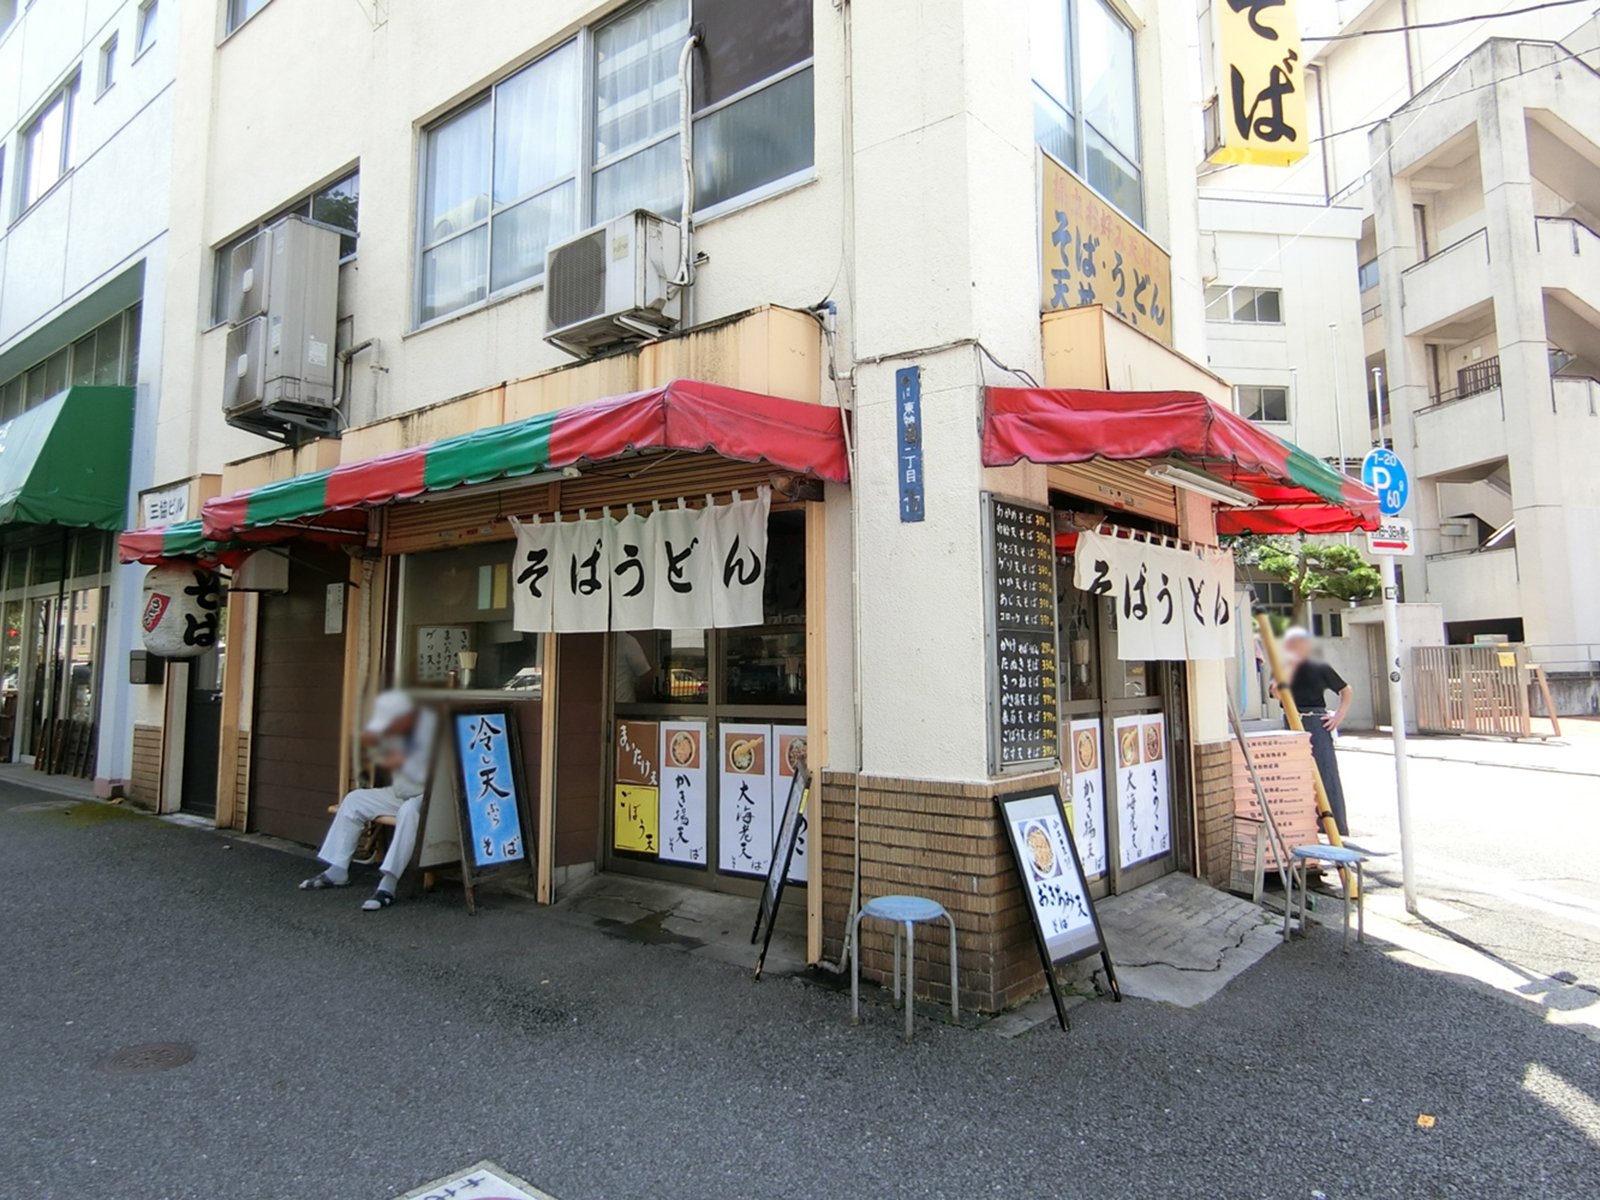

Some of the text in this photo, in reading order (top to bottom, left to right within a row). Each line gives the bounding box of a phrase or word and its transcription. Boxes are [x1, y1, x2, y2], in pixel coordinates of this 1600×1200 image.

[1373, 454, 1397, 466] 7-20
[1372, 466, 1391, 489] P
[517, 534, 762, 598] そばうどん
